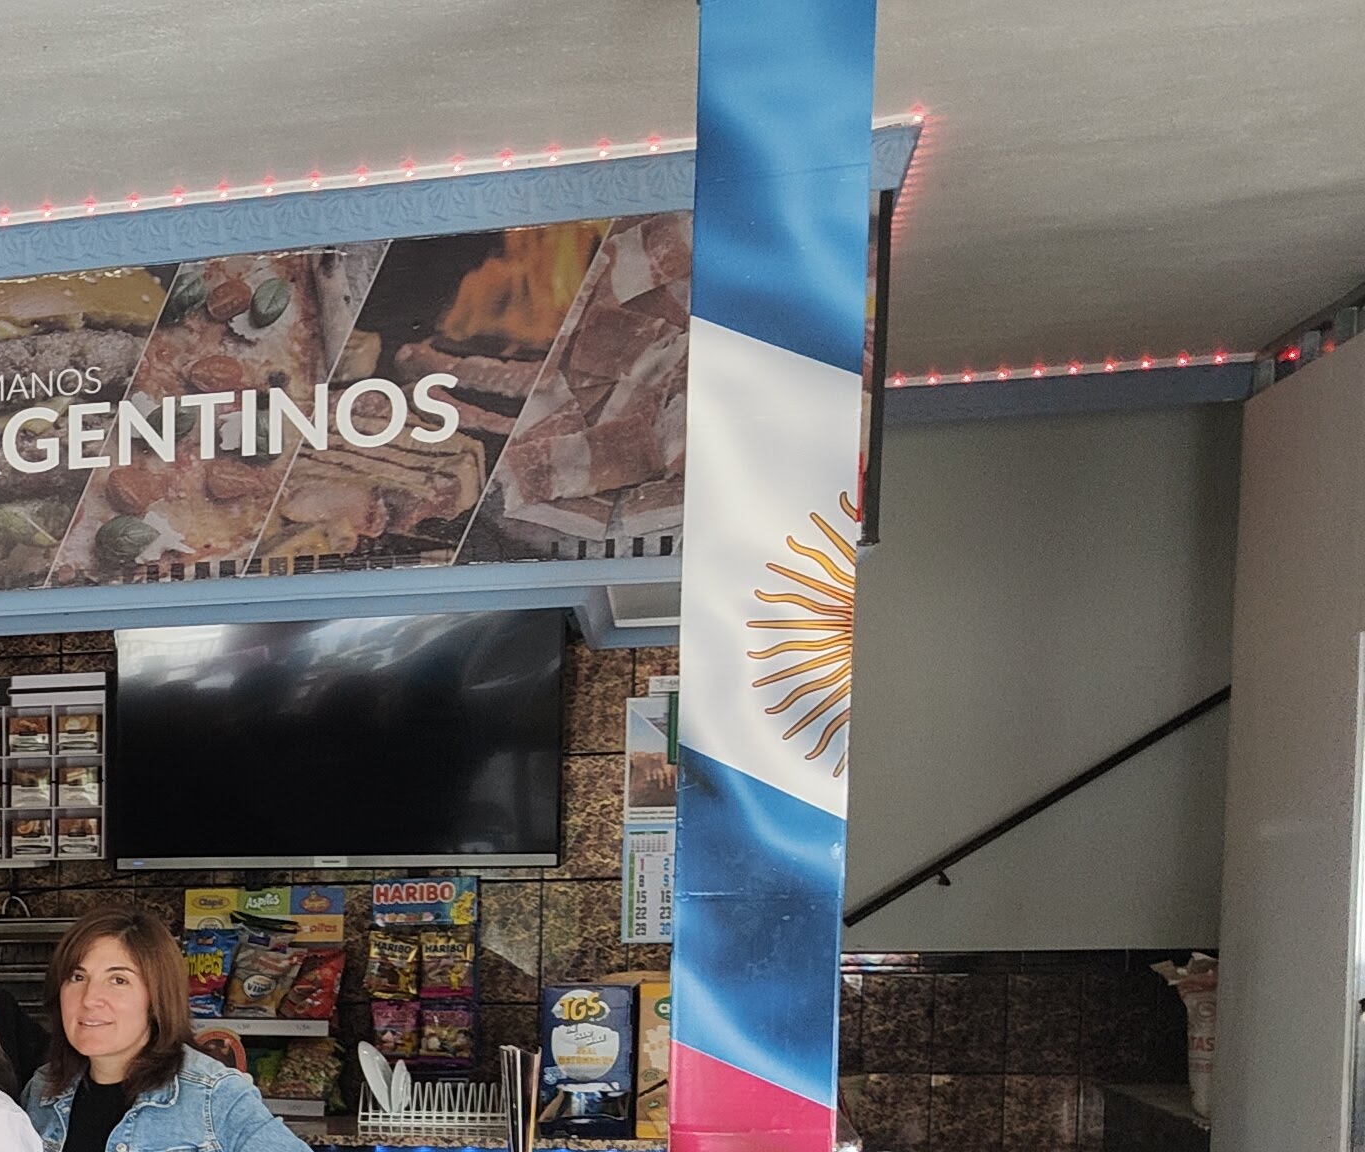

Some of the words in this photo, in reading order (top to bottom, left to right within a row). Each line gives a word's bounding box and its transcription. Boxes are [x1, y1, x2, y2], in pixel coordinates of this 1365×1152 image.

[374, 882, 455, 904] HARIBO
[636, 890, 647, 904] 15
[660, 889, 671, 904] 16
[374, 940, 412, 954] HARIBO
[424, 943, 464, 953] HARIBO
[559, 991, 602, 1020] TGS
